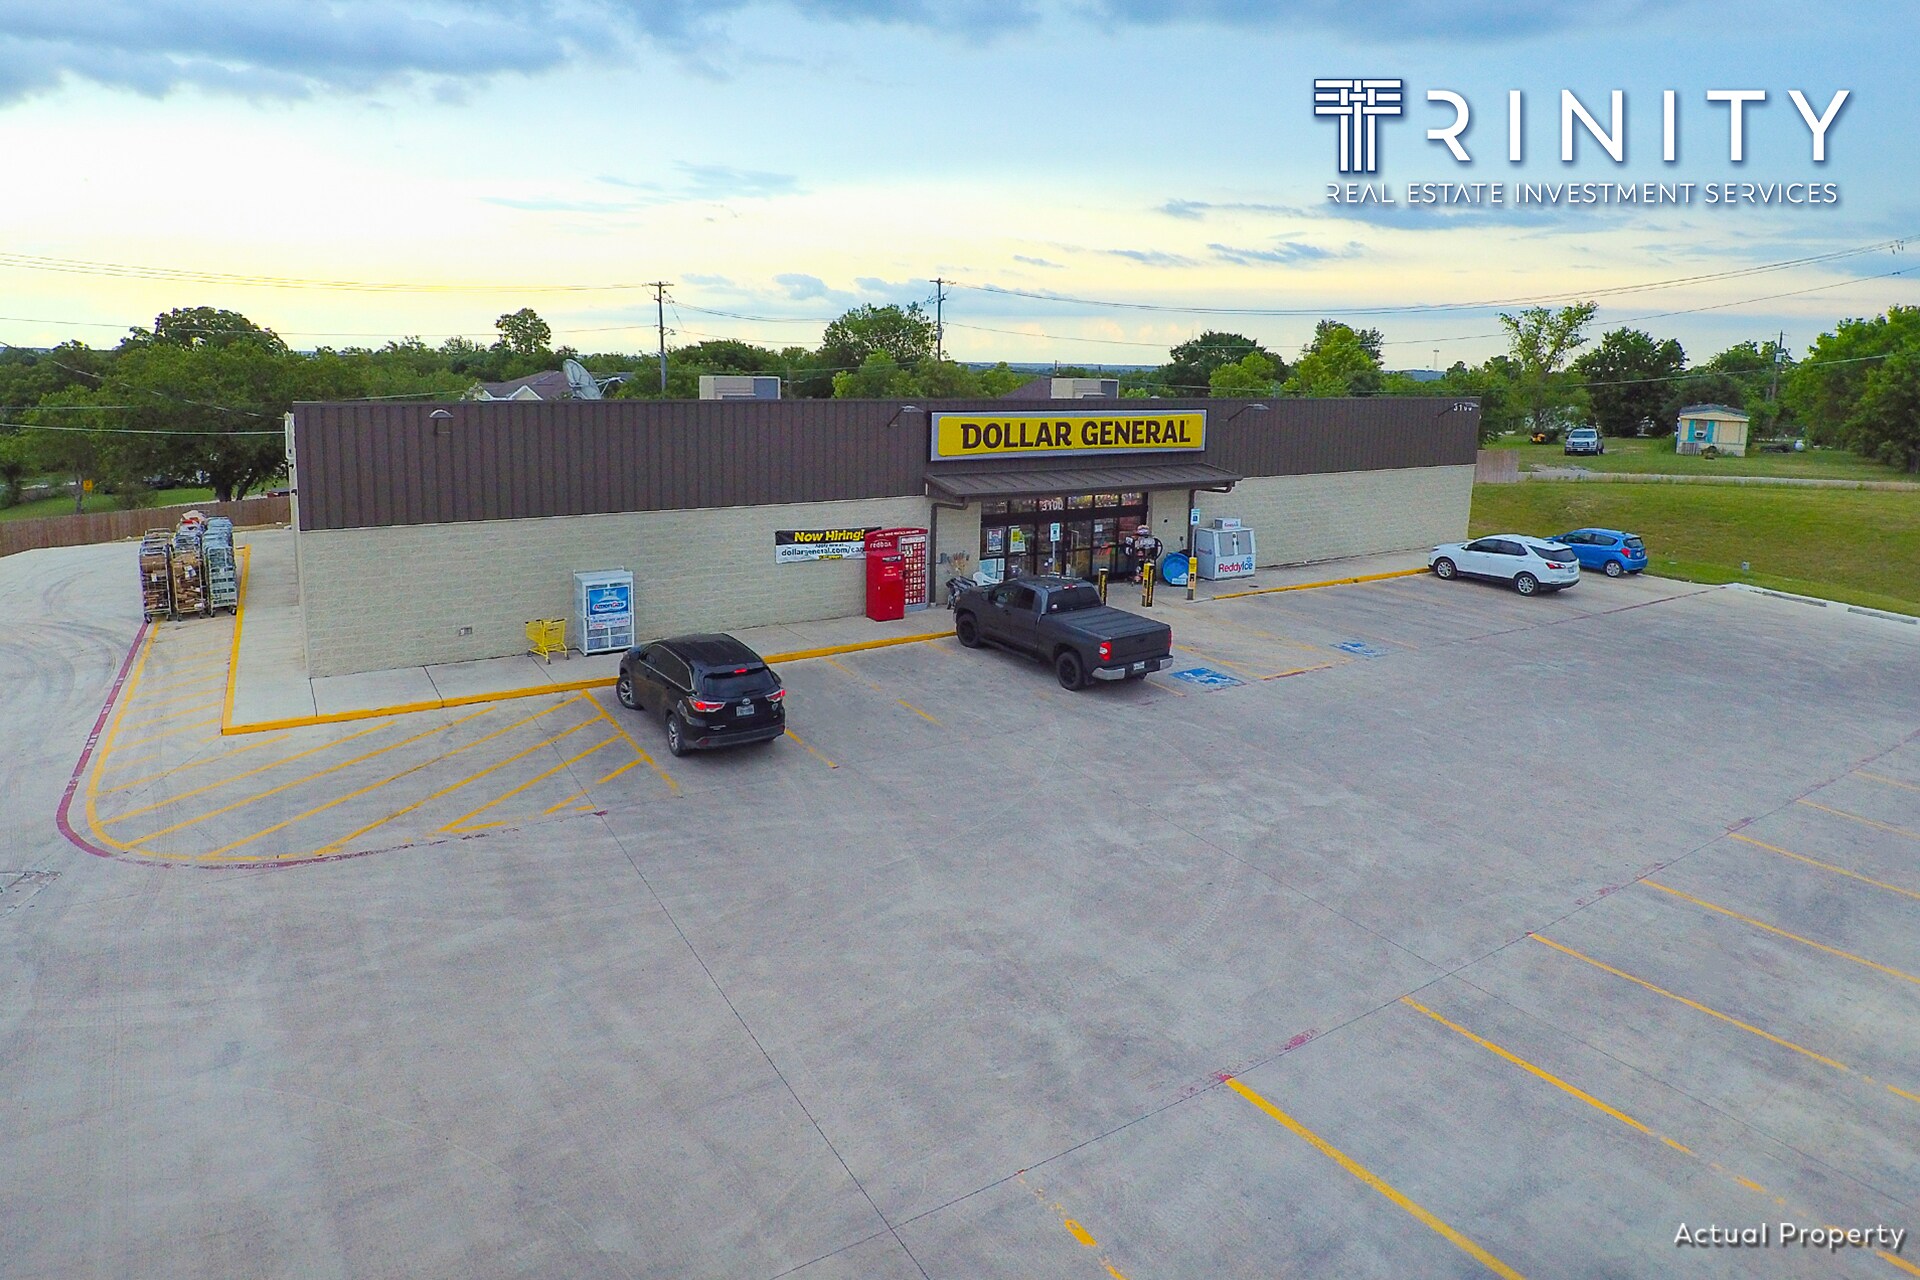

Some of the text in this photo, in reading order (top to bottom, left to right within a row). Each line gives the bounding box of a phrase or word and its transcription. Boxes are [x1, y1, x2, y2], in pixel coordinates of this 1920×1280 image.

[961, 420, 1190, 449] DOLLAR GENERAL
[1041, 499, 1064, 511] 3100
[794, 532, 823, 542] Now
[825, 529, 865, 542] Hiring!
[870, 541, 892, 549] redbox
